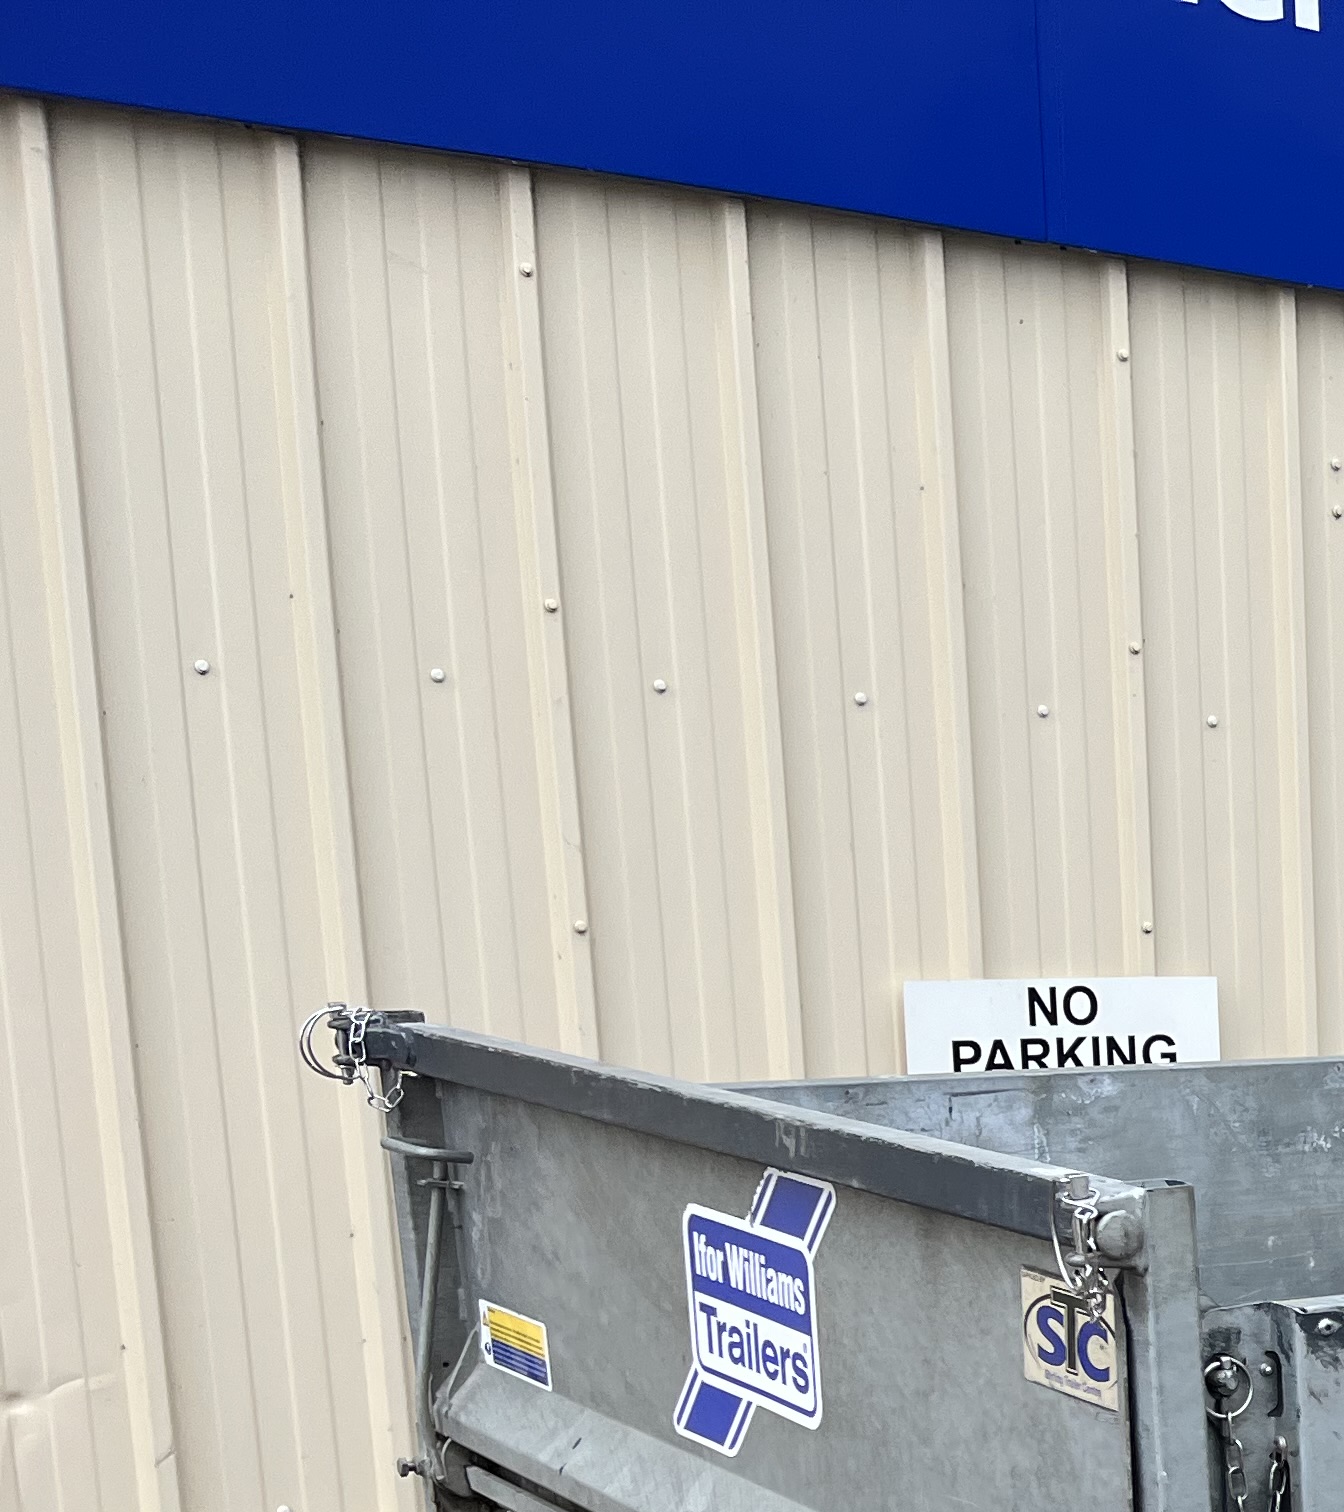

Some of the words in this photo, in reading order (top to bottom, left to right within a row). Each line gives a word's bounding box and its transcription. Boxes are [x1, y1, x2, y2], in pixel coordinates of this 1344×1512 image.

[1026, 985, 1099, 1028] NO
[951, 1034, 1178, 1074] PARKING
[692, 1230, 725, 1284] Ifor
[724, 1241, 806, 1316] Williams
[698, 1300, 810, 1395] Trailers
